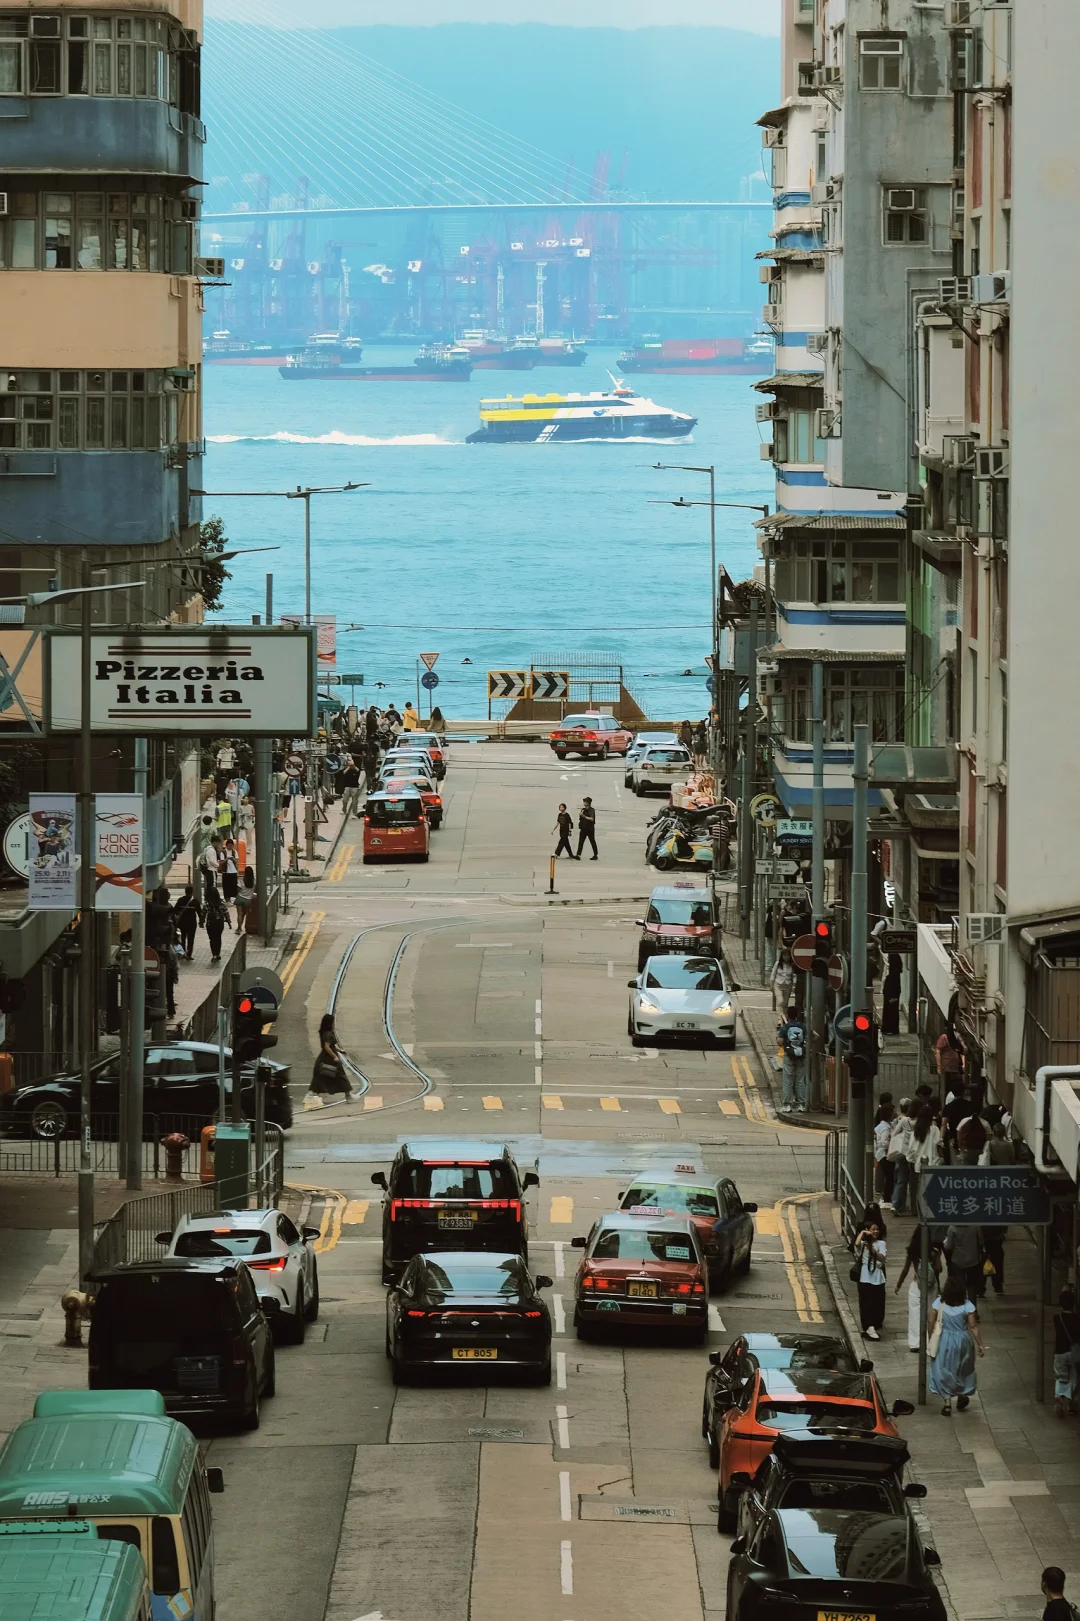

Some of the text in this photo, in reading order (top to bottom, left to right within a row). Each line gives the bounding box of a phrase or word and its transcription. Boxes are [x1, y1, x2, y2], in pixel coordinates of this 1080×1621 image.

[95, 660, 265, 681] Pizzeria
[116, 684, 243, 704] Italia
[99, 834, 139, 844] HONG
[99, 844, 139, 854] KONG
[938, 1175, 998, 1189] Victoria
[633, 1206, 662, 1214] TAXI
[938, 1195, 1027, 1216] 域多利道
[457, 1349, 492, 1358] CT 805
[23, 1492, 69, 1506] AMS
[824, 1612, 839, 1621] YH
